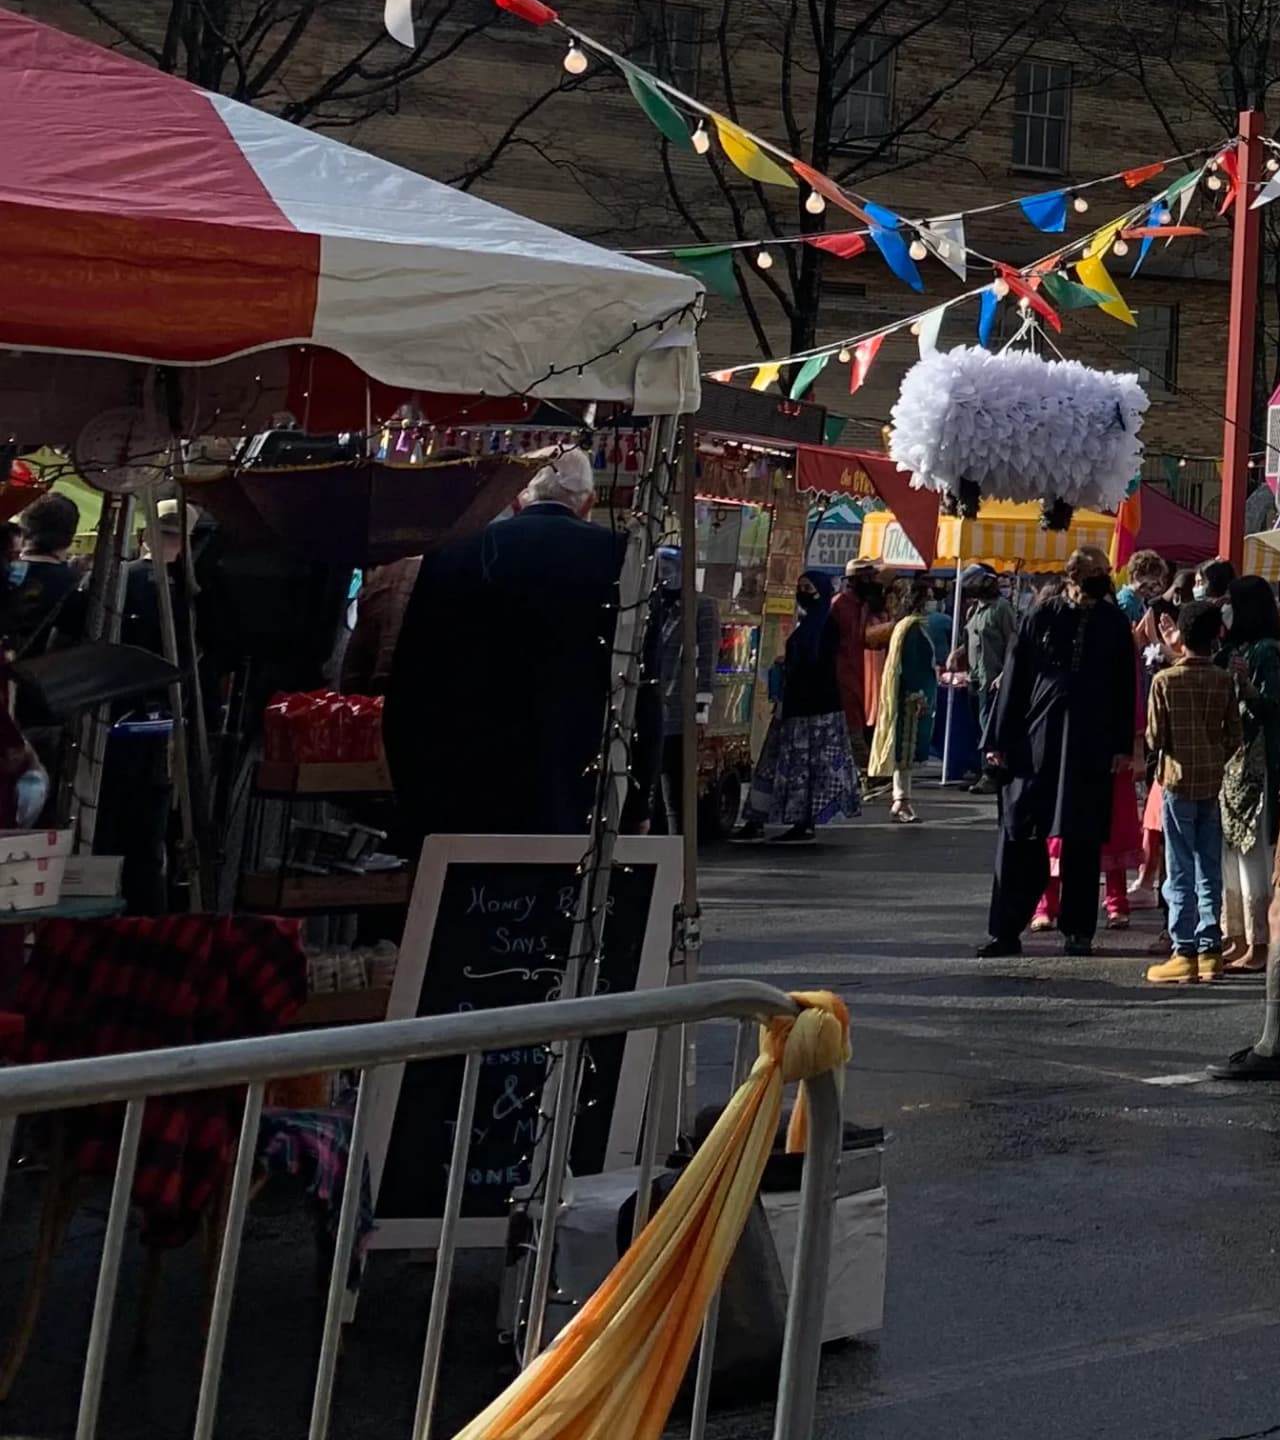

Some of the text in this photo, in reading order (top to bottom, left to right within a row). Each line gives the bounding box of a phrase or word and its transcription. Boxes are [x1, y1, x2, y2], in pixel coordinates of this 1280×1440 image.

[481, 1048, 546, 1065] ENSIB
[492, 1073, 526, 1120] &
[441, 1120, 488, 1146] TY
[441, 1162, 522, 1185] ONE
